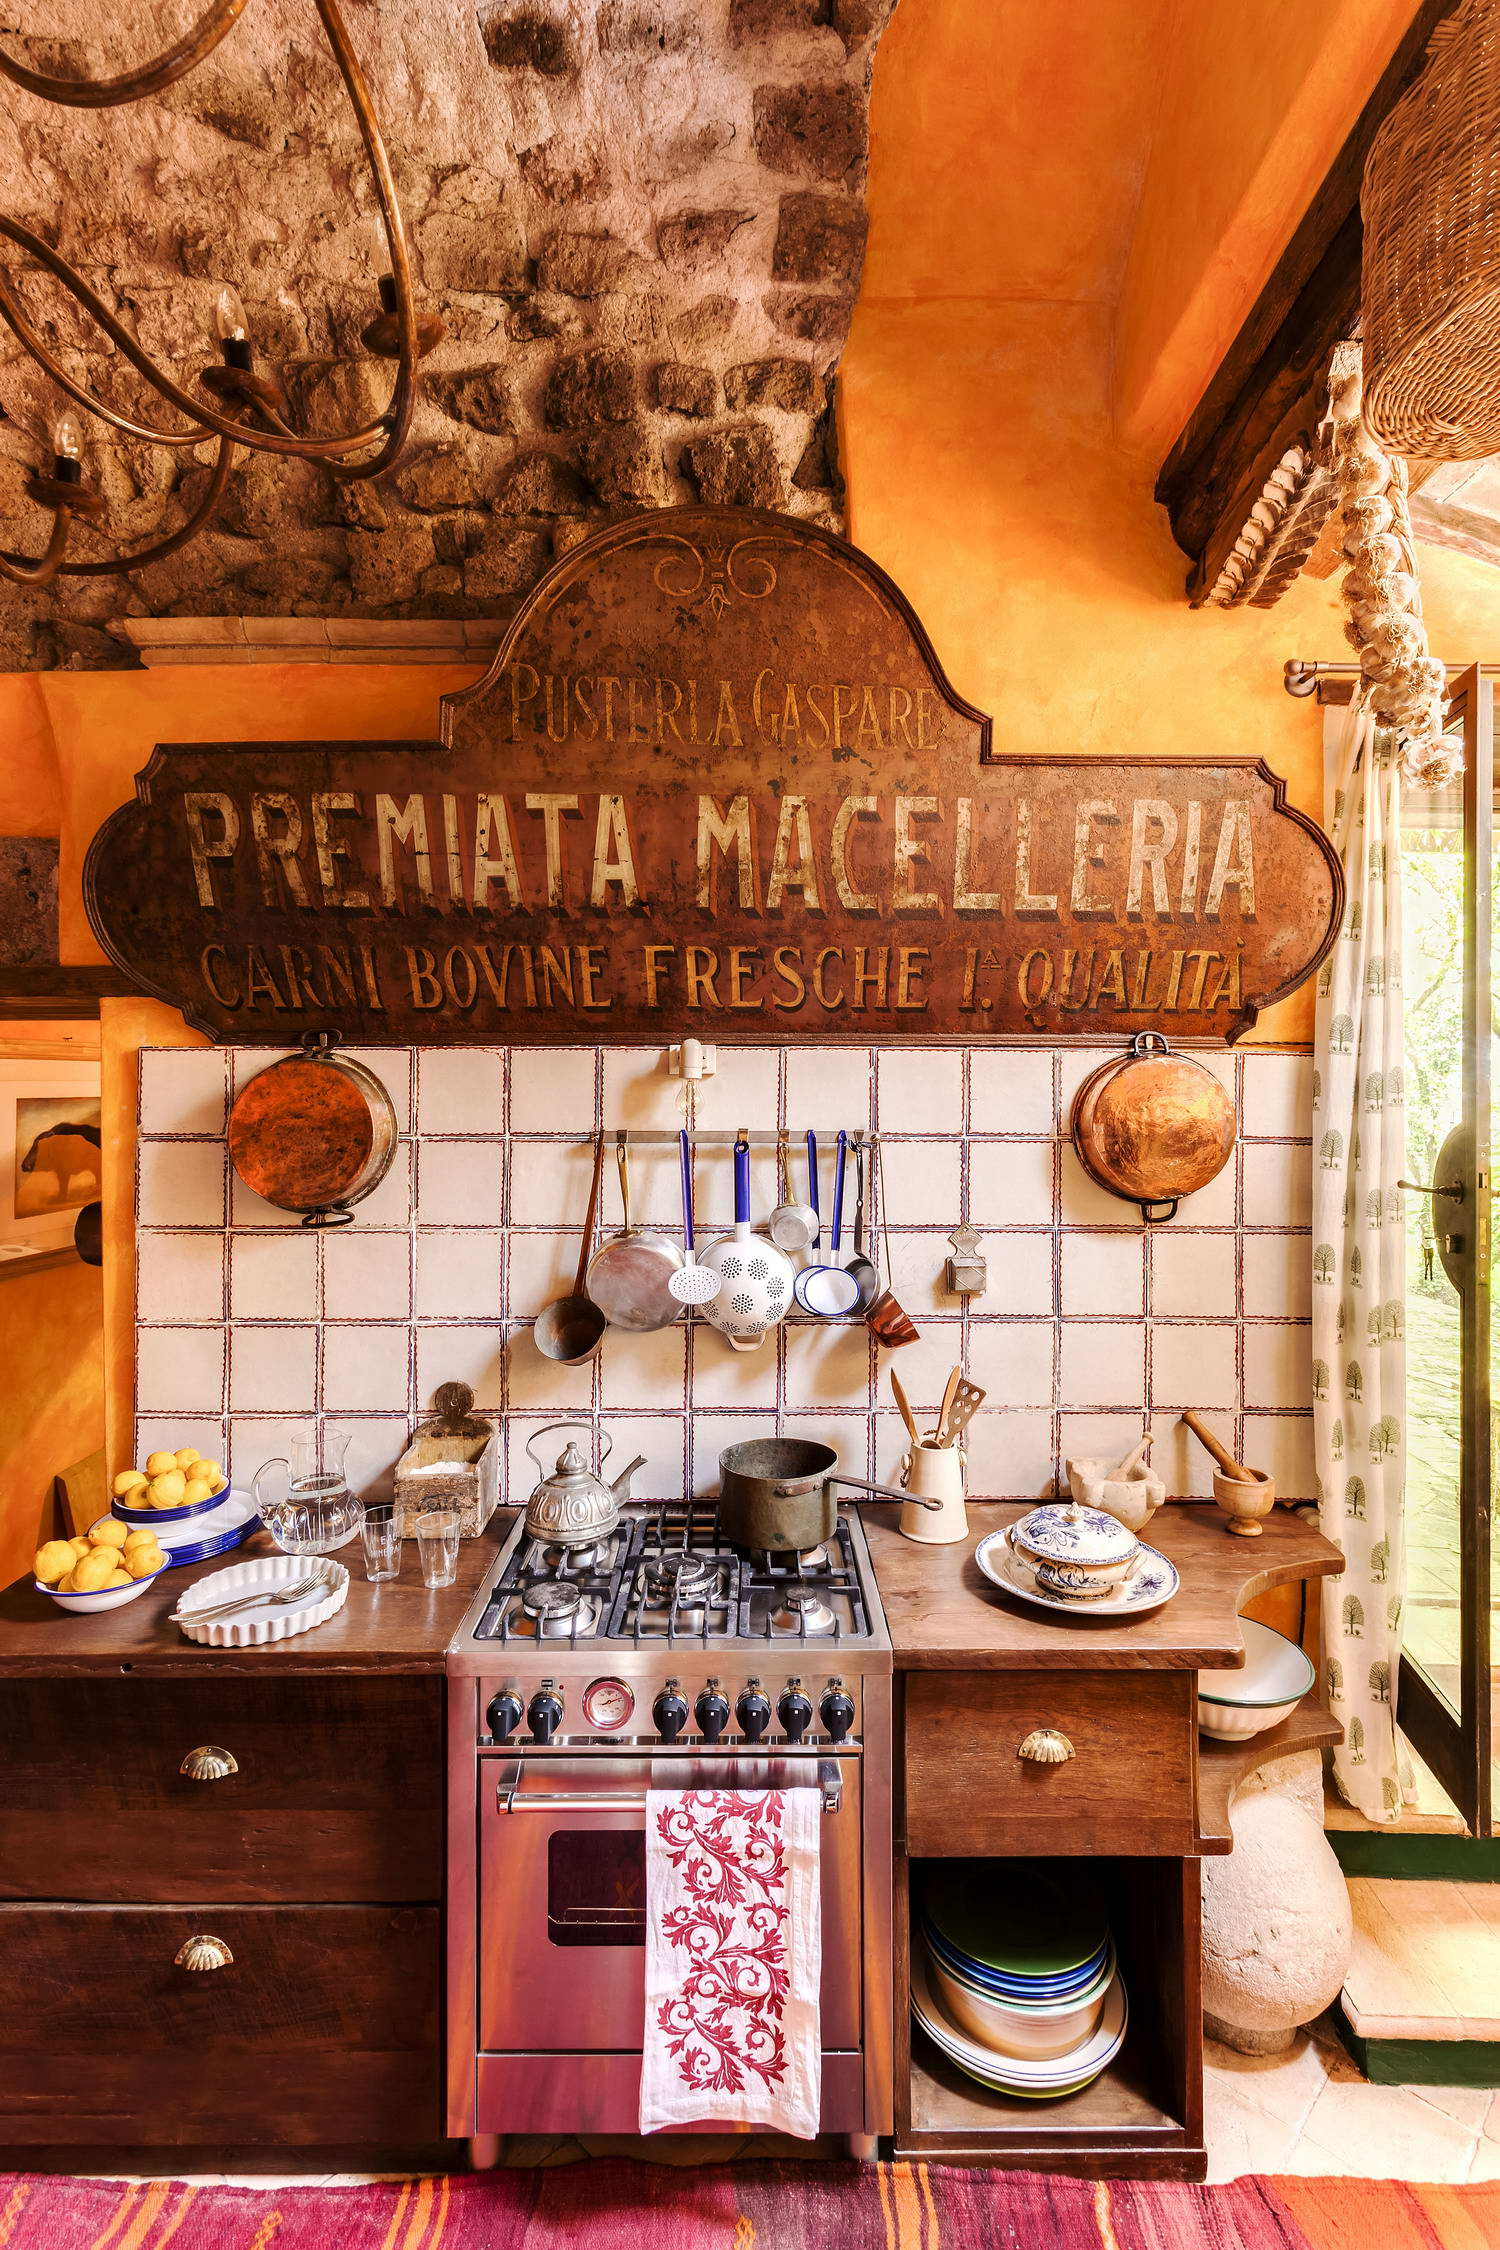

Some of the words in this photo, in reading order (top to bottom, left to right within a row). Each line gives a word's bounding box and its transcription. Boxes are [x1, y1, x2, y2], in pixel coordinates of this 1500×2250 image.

[752, 668, 940, 751] GASPARE
[183, 791, 639, 910] PREMIATA
[695, 794, 1258, 916] MACELLERIA
[201, 942, 385, 1010] CARNI
[403, 943, 612, 1009] BOVINE
[641, 944, 930, 1010] FRESCHE
